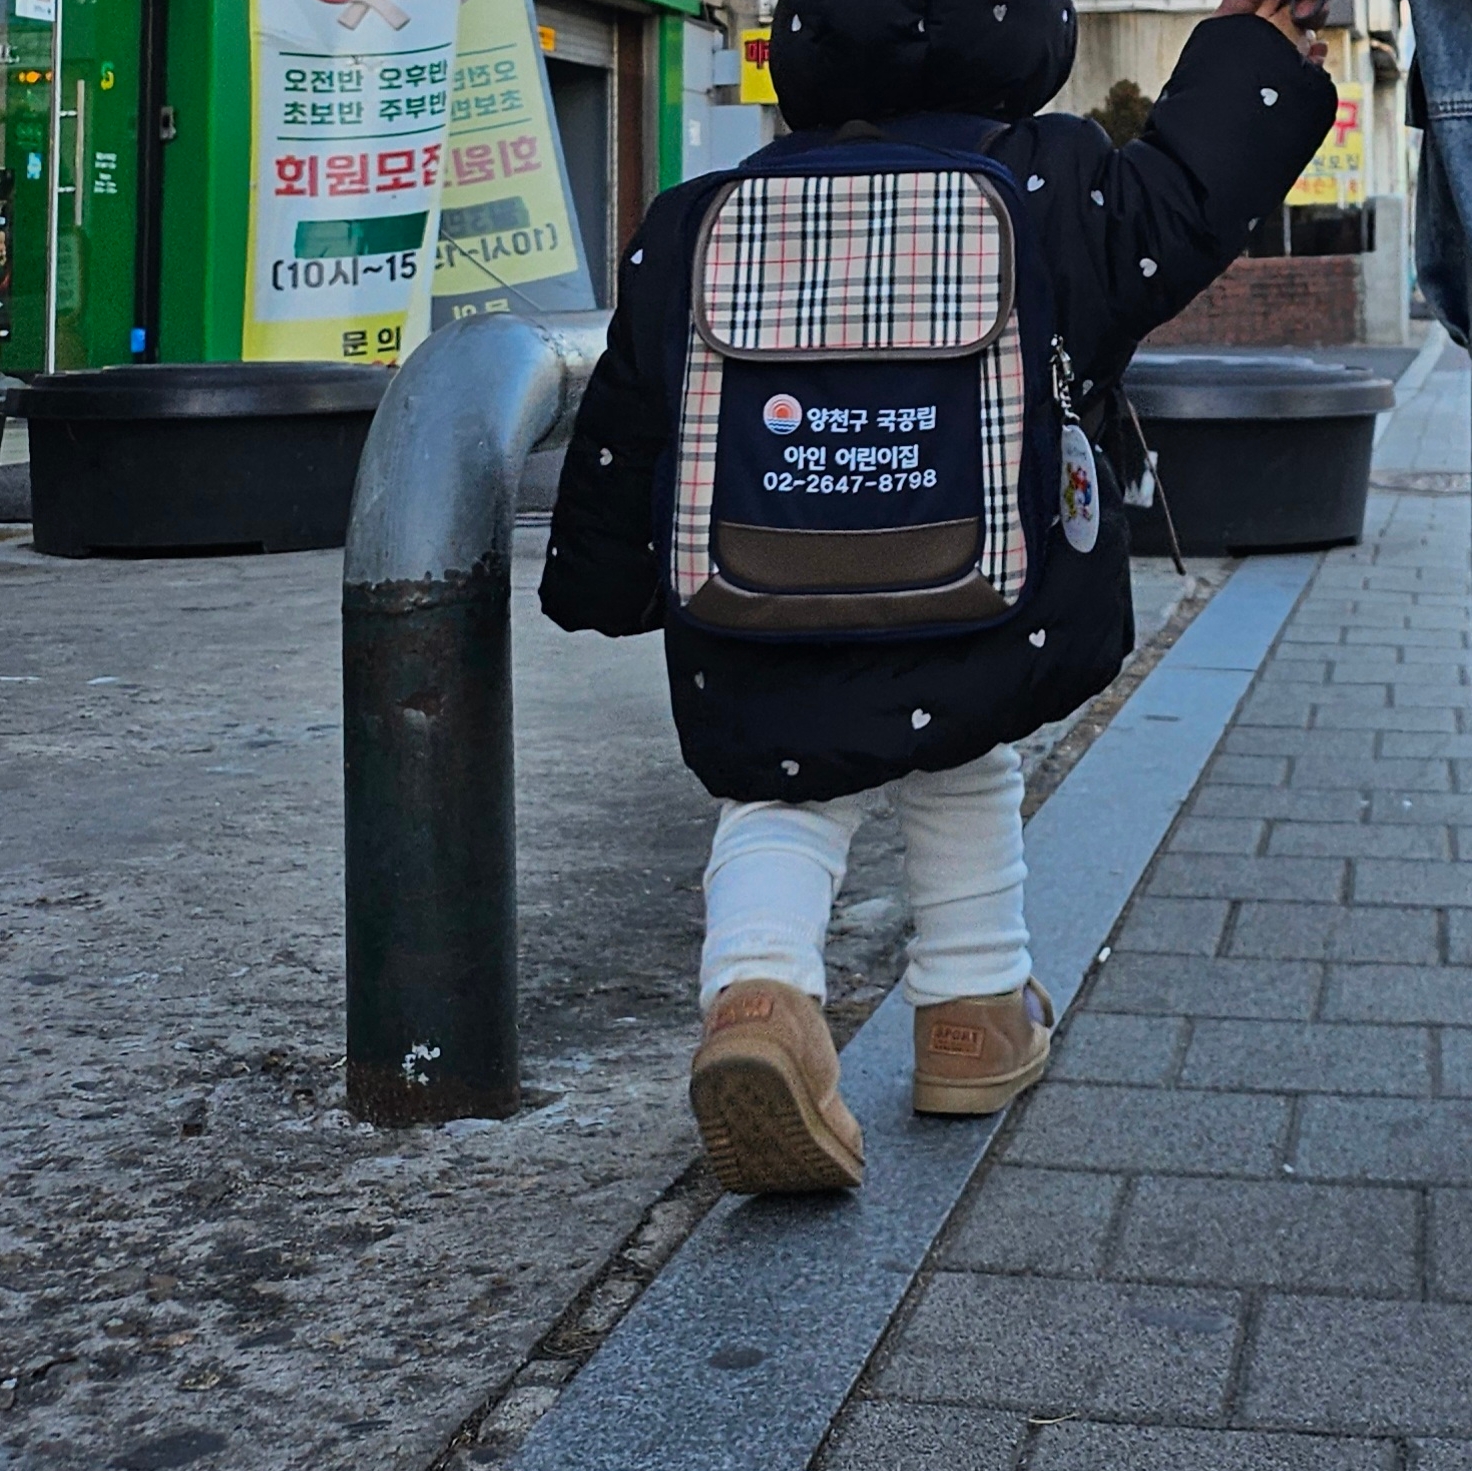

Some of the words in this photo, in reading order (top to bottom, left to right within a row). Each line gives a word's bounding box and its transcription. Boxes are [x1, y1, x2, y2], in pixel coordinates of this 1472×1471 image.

[284, 68, 363, 93] 오전반
[379, 60, 447, 90] 오후반
[284, 100, 363, 125] 초보반
[379, 91, 447, 122] 주부반
[806, 406, 869, 433] 양천구
[876, 405, 937, 432] 국공립
[783, 445, 827, 472] 아인
[834, 444, 920, 472] 어린이집
[763, 469, 938, 494] 02-2647-8798
